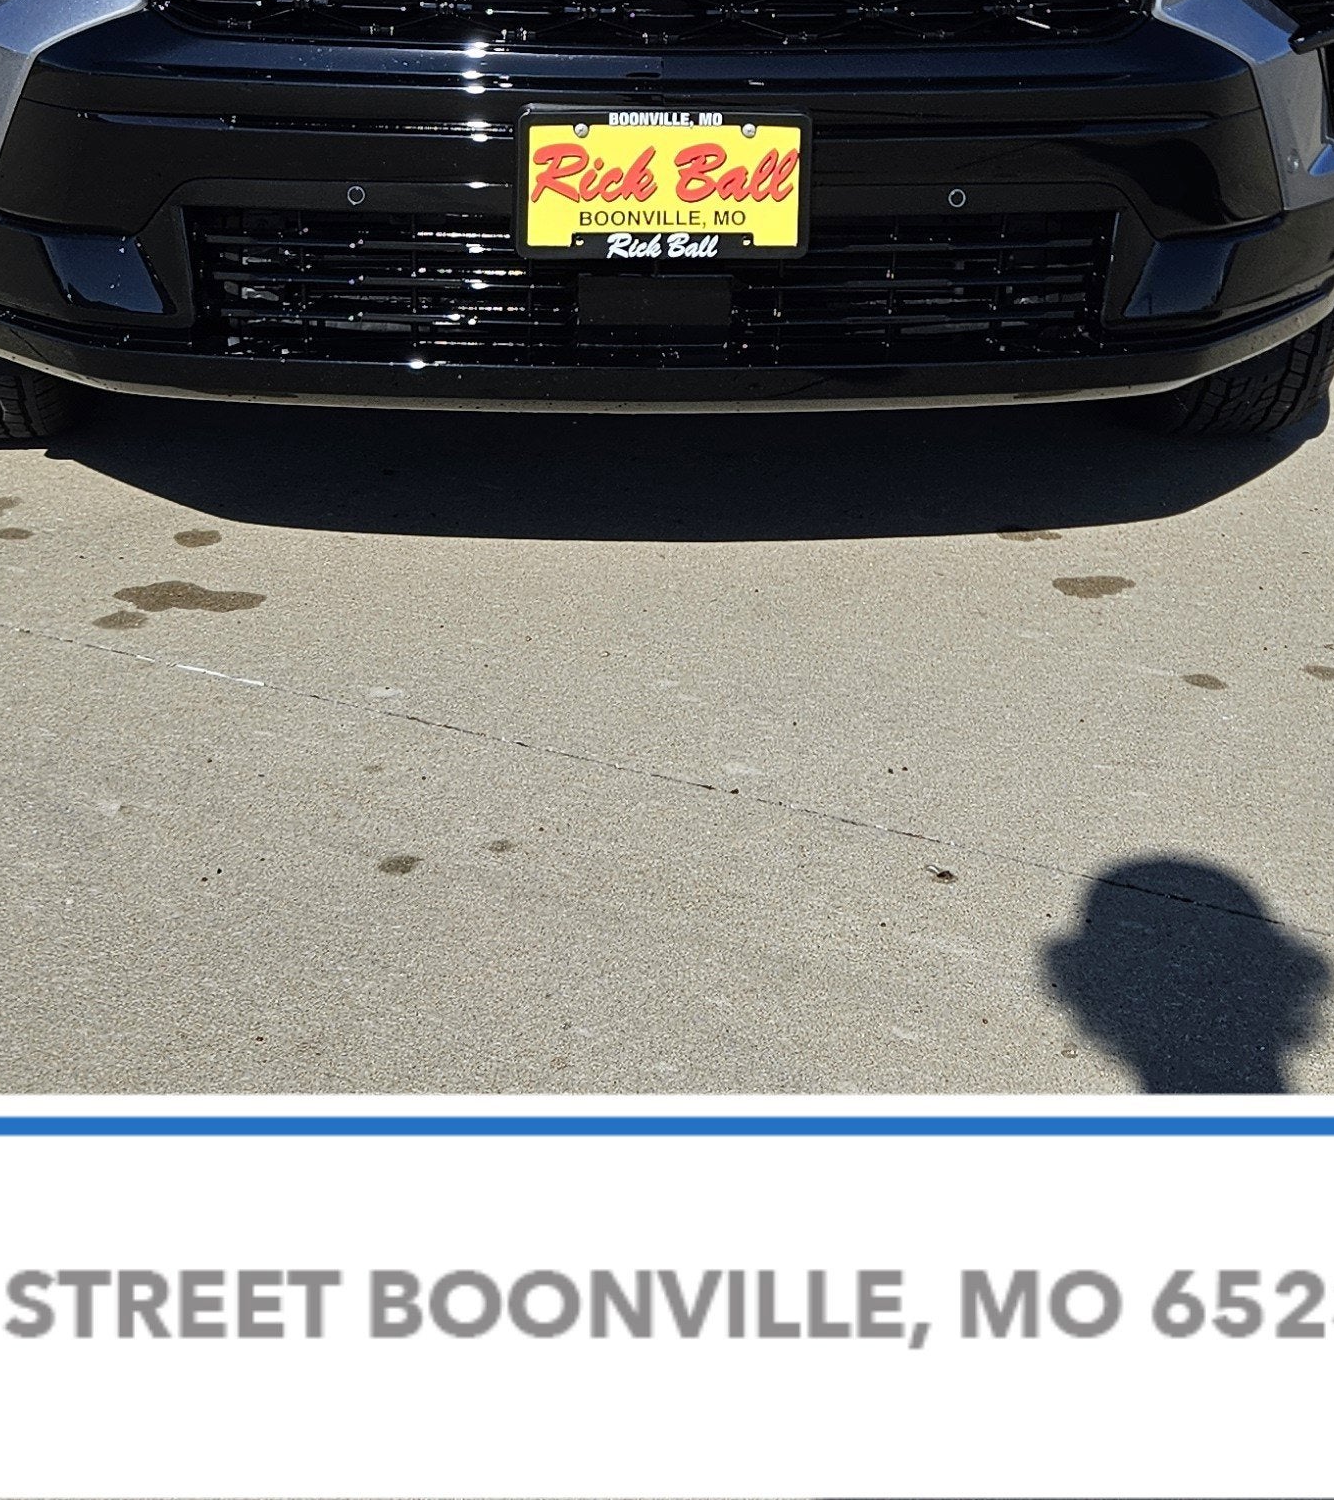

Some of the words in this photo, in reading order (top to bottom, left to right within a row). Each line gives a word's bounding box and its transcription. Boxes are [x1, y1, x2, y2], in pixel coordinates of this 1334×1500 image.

[608, 111, 694, 128] BOONVILLE,
[698, 112, 723, 127] MO
[530, 142, 658, 204] Rick
[674, 142, 800, 203] Ball
[578, 209, 707, 228] BOONVILLE,
[713, 210, 747, 227] MO
[606, 232, 662, 259] Rick
[666, 232, 719, 259] Ball
